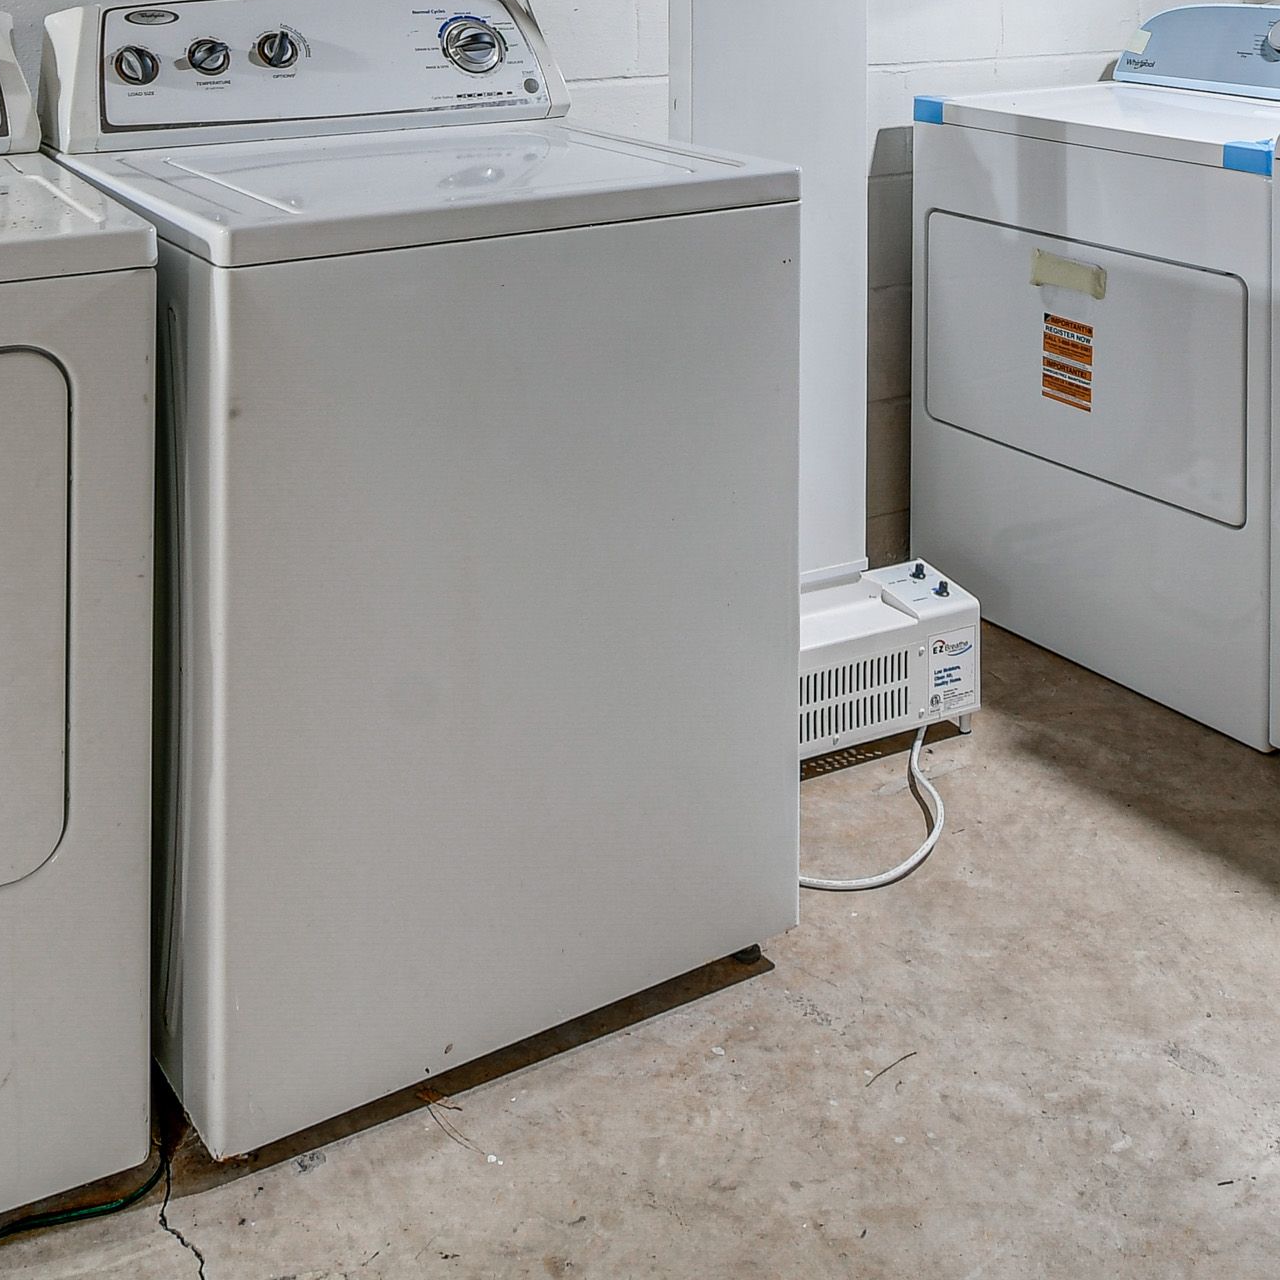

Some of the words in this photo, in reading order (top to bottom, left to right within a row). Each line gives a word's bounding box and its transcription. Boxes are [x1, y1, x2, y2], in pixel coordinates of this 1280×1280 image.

[1125, 58, 1156, 70] Whirlpool
[1045, 325, 1075, 340] REGISTER
[1076, 334, 1091, 345] NOW
[933, 645, 944, 655] EZ
